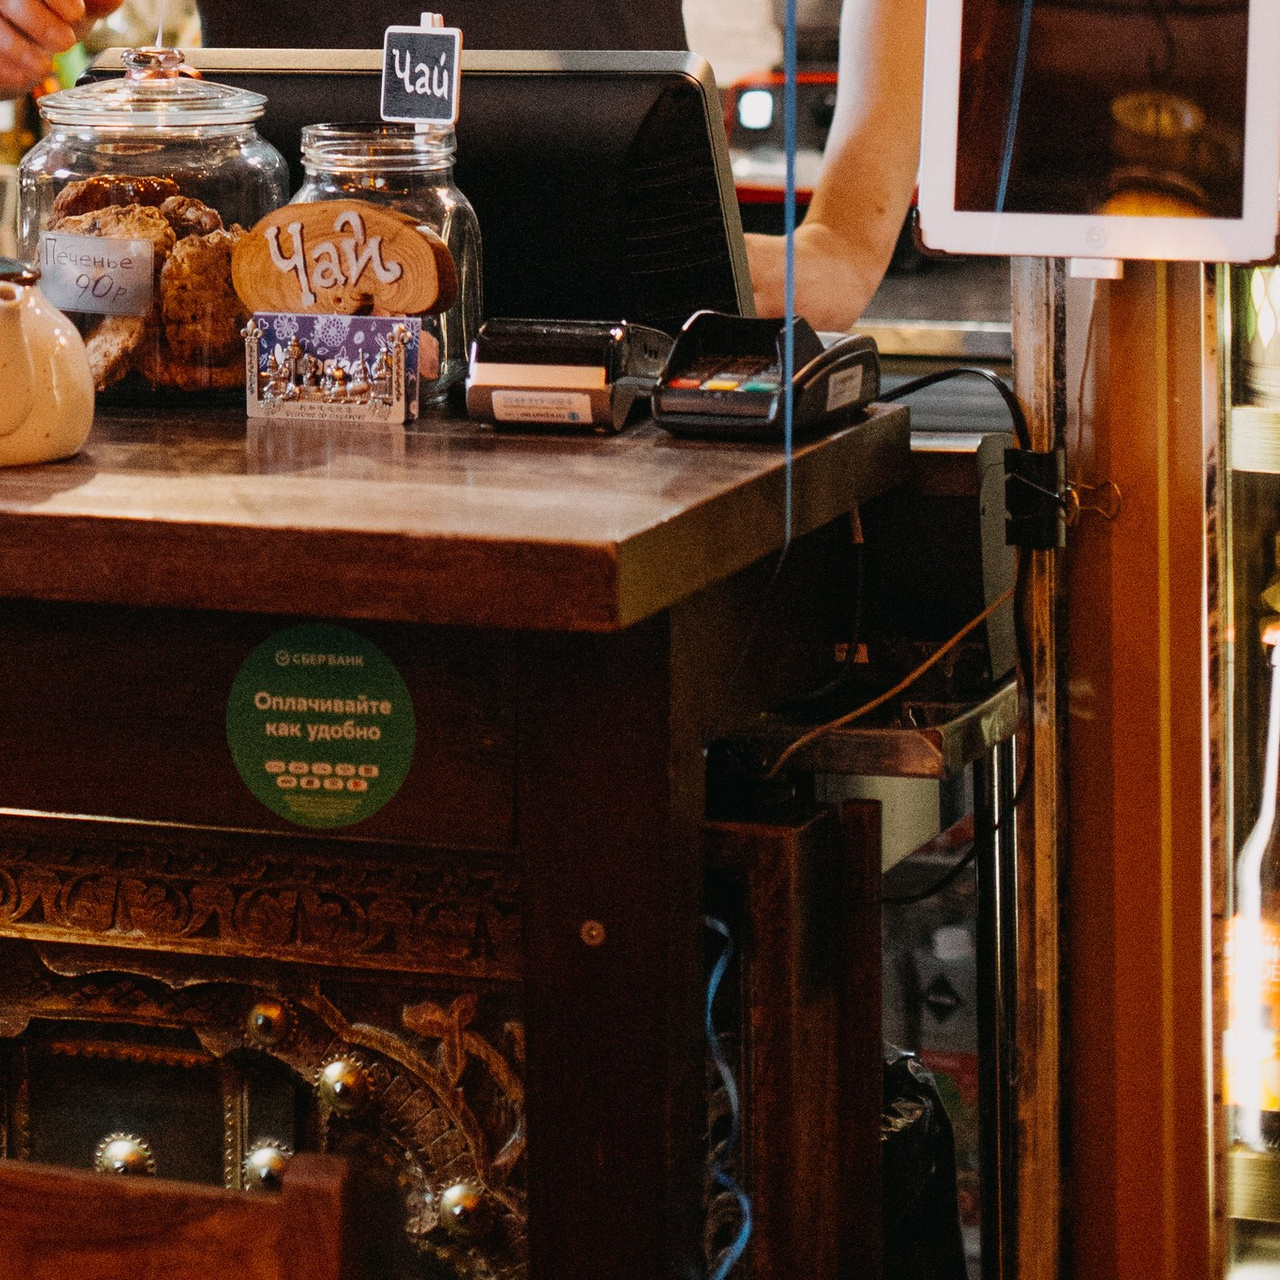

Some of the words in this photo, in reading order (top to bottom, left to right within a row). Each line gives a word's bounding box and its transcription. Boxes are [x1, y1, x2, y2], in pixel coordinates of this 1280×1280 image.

[391, 48, 449, 100] Чай
[45, 237, 133, 270] Печенье
[264, 210, 404, 307] Чай
[292, 652, 364, 667] СБЕРБАНК
[253, 690, 393, 716] Оплачивайте
[265, 722, 301, 737] как
[307, 719, 381, 742] удобно
